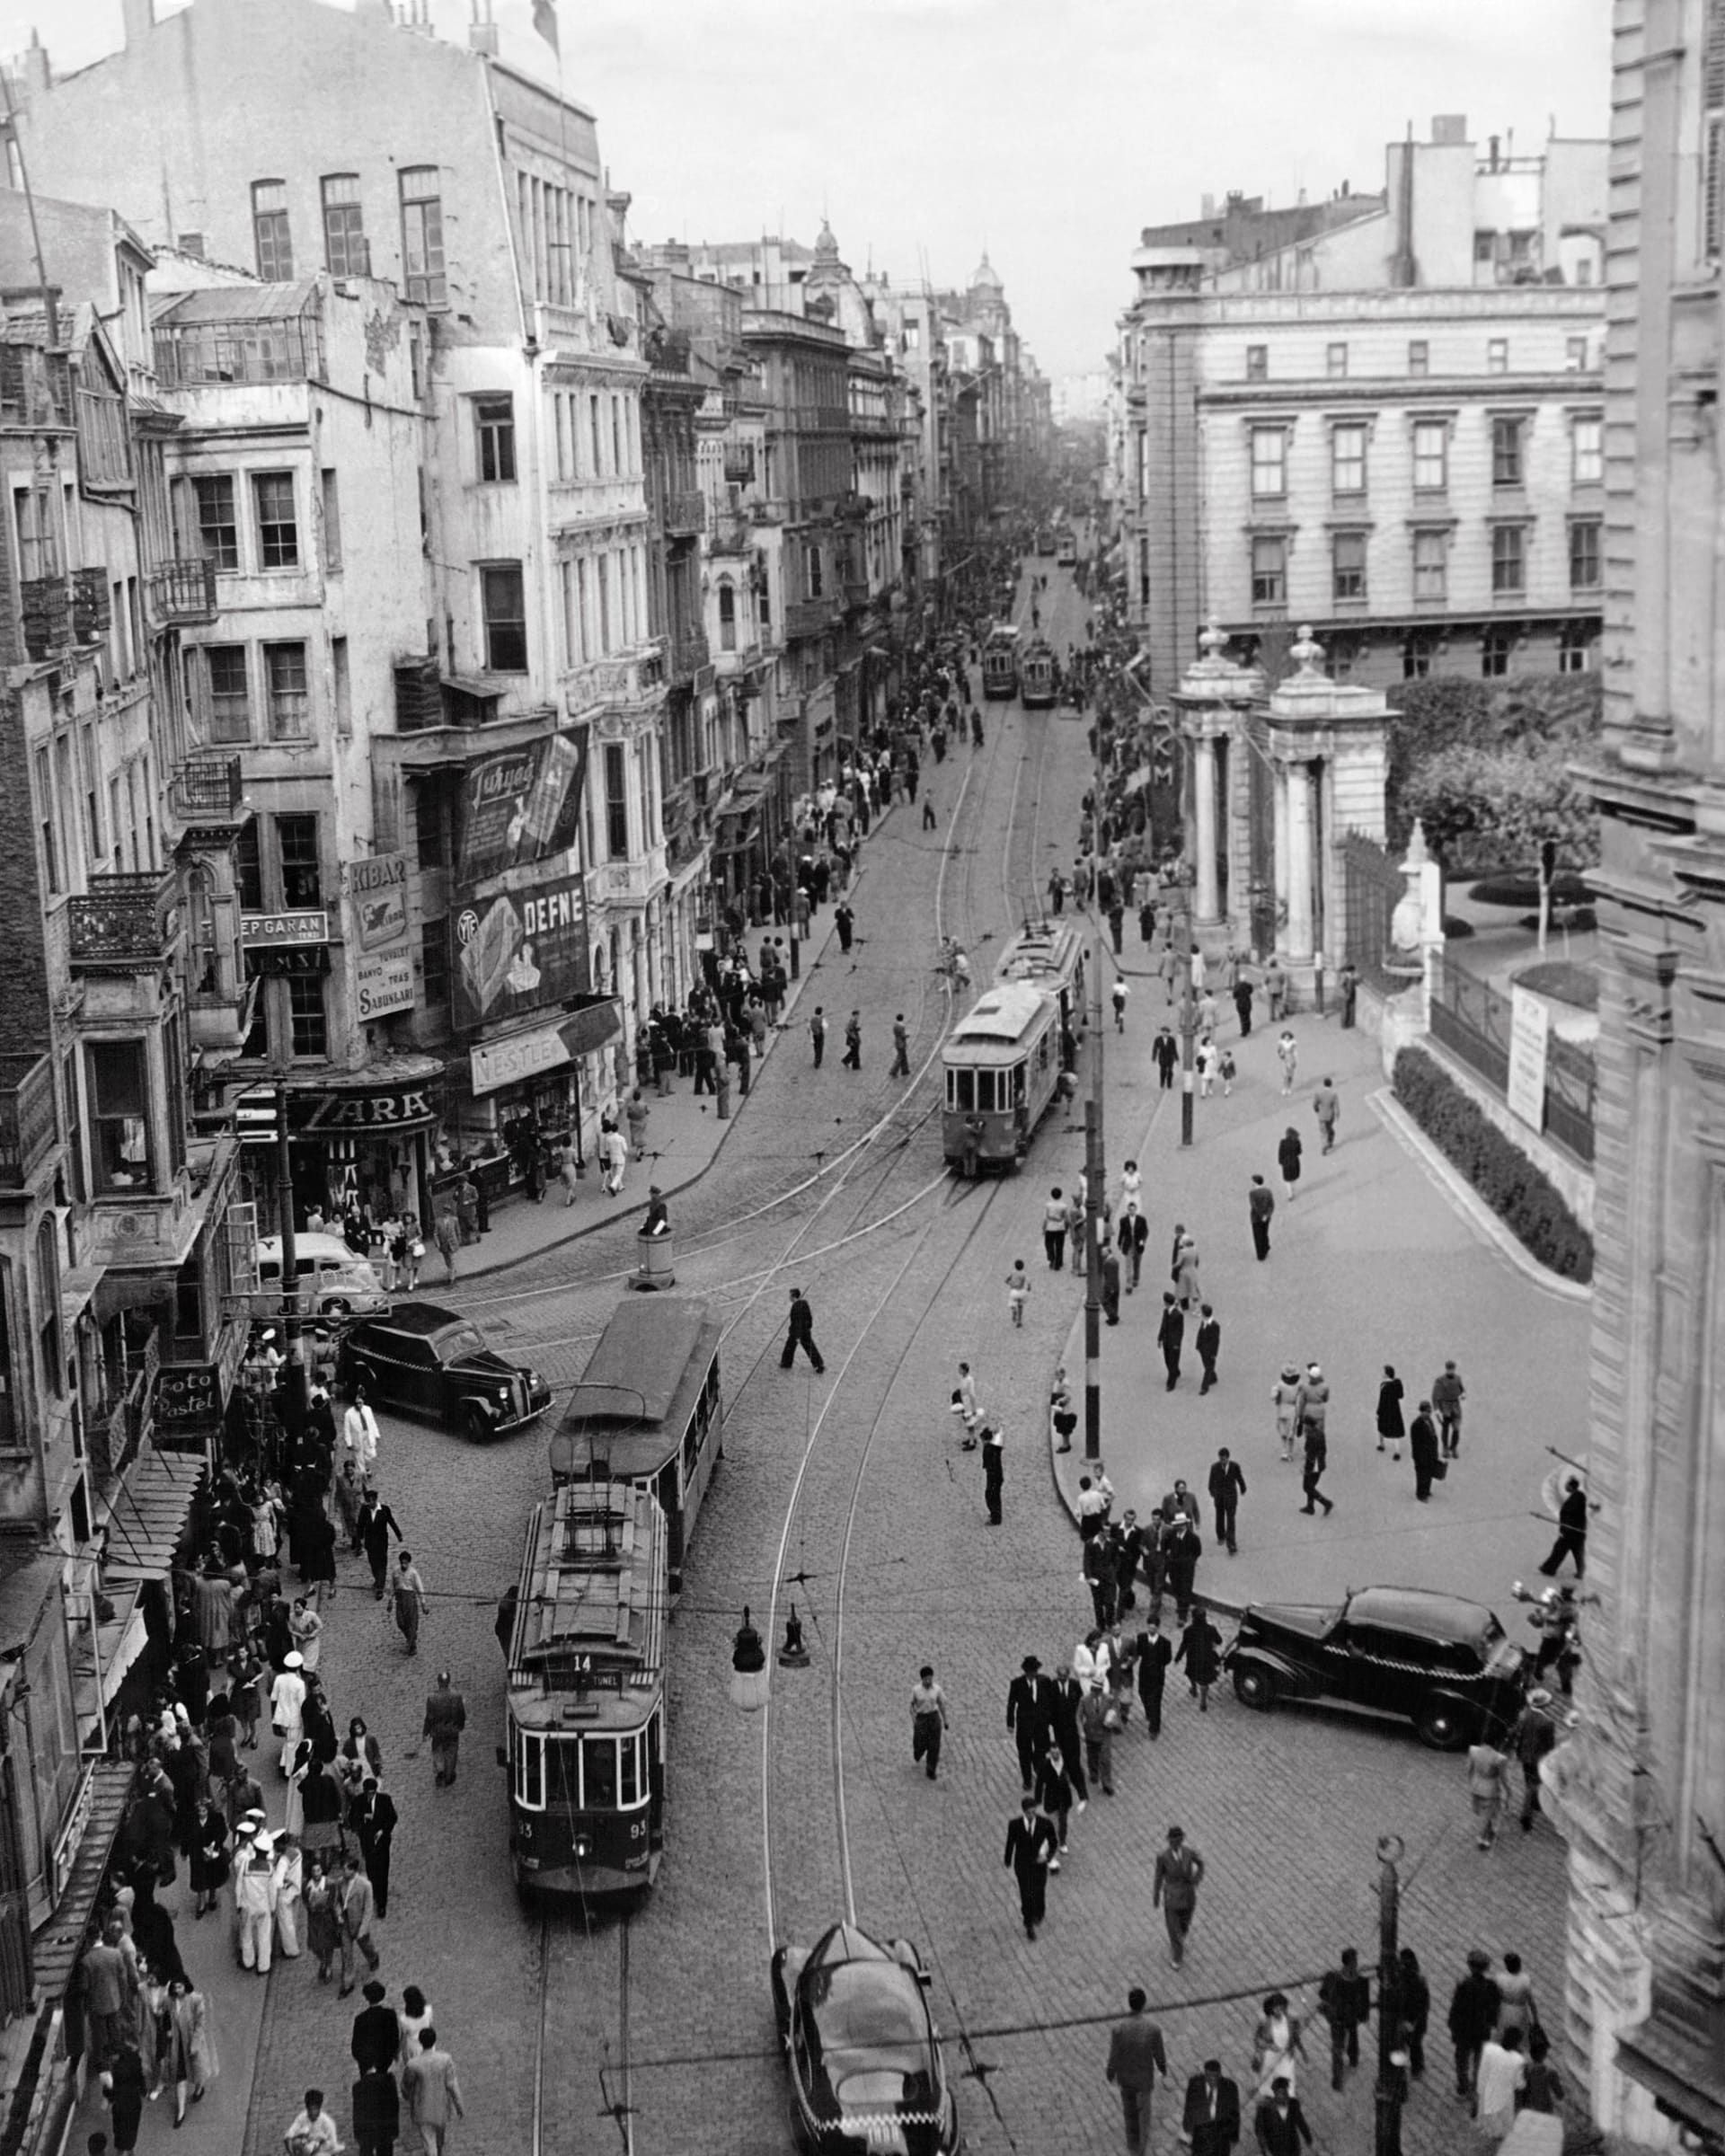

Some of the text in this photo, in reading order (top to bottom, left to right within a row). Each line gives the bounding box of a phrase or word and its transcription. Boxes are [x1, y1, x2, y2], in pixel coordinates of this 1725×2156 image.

[524, 888, 583, 936] DEFNE
[264, 917, 320, 934] GARAN
[358, 967, 382, 981] BANYO
[299, 1091, 430, 1132] ZARA
[159, 1372, 211, 1398] Foto
[574, 1655, 591, 1673] 14
[630, 1819, 647, 1840] 93
